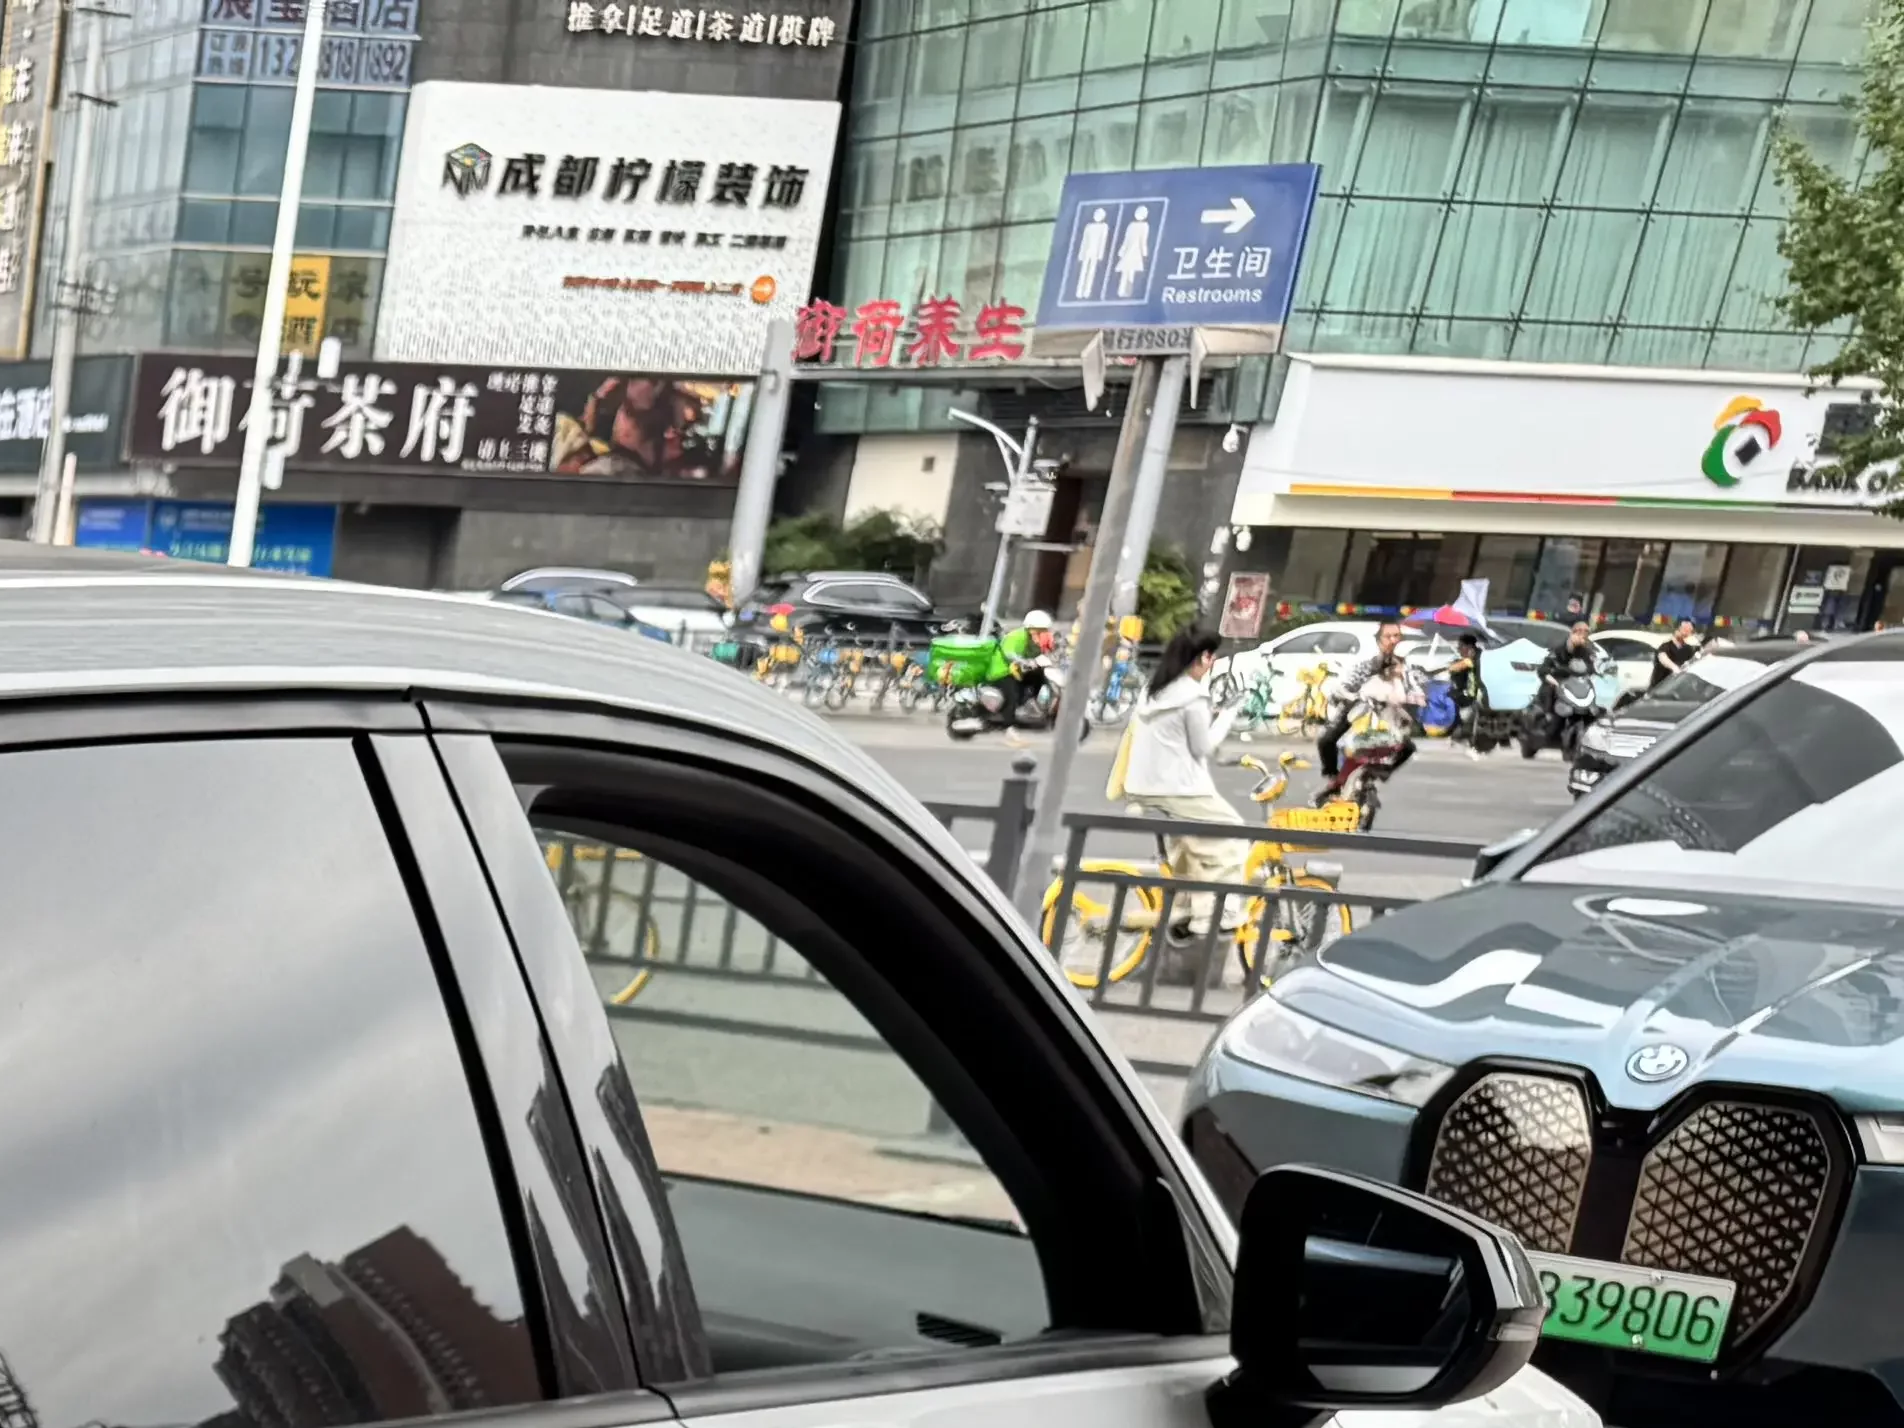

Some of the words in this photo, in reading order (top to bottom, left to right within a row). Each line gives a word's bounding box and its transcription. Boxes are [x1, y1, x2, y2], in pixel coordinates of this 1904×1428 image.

[495, 153, 809, 207] 成都柠檬装饰
[1167, 245, 1271, 280] 卫生间
[1161, 286, 1263, 304] Restrooms
